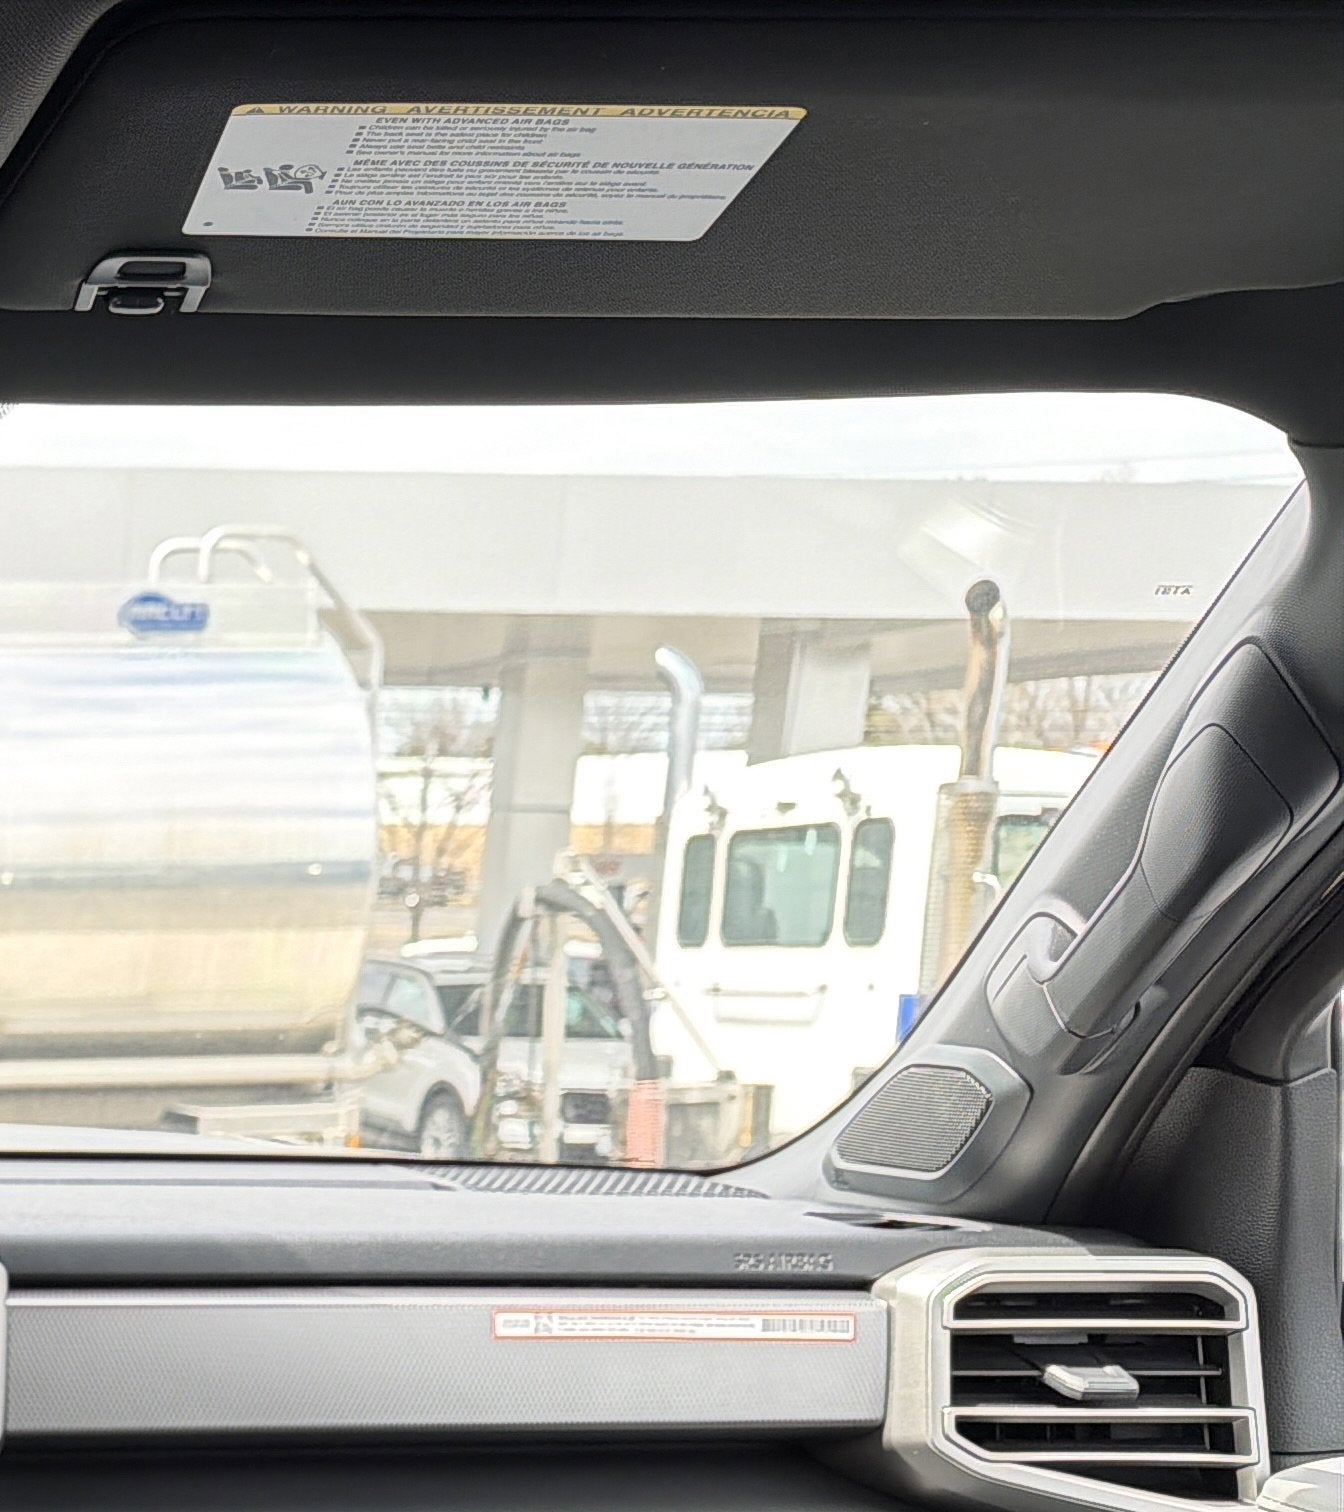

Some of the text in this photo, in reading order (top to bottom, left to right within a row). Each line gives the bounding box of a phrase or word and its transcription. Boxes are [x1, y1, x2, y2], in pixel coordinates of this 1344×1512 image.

[278, 105, 792, 118] WARNING AVERTISSEMENT ADVERTENCIA
[512, 118, 533, 126] AIR
[534, 118, 570, 126] BAGS
[450, 160, 510, 168] COUSSINS
[531, 160, 589, 168] SÉCURITÉ
[612, 162, 675, 170] NOUVELLE
[678, 161, 756, 171] GÉNÉRATION
